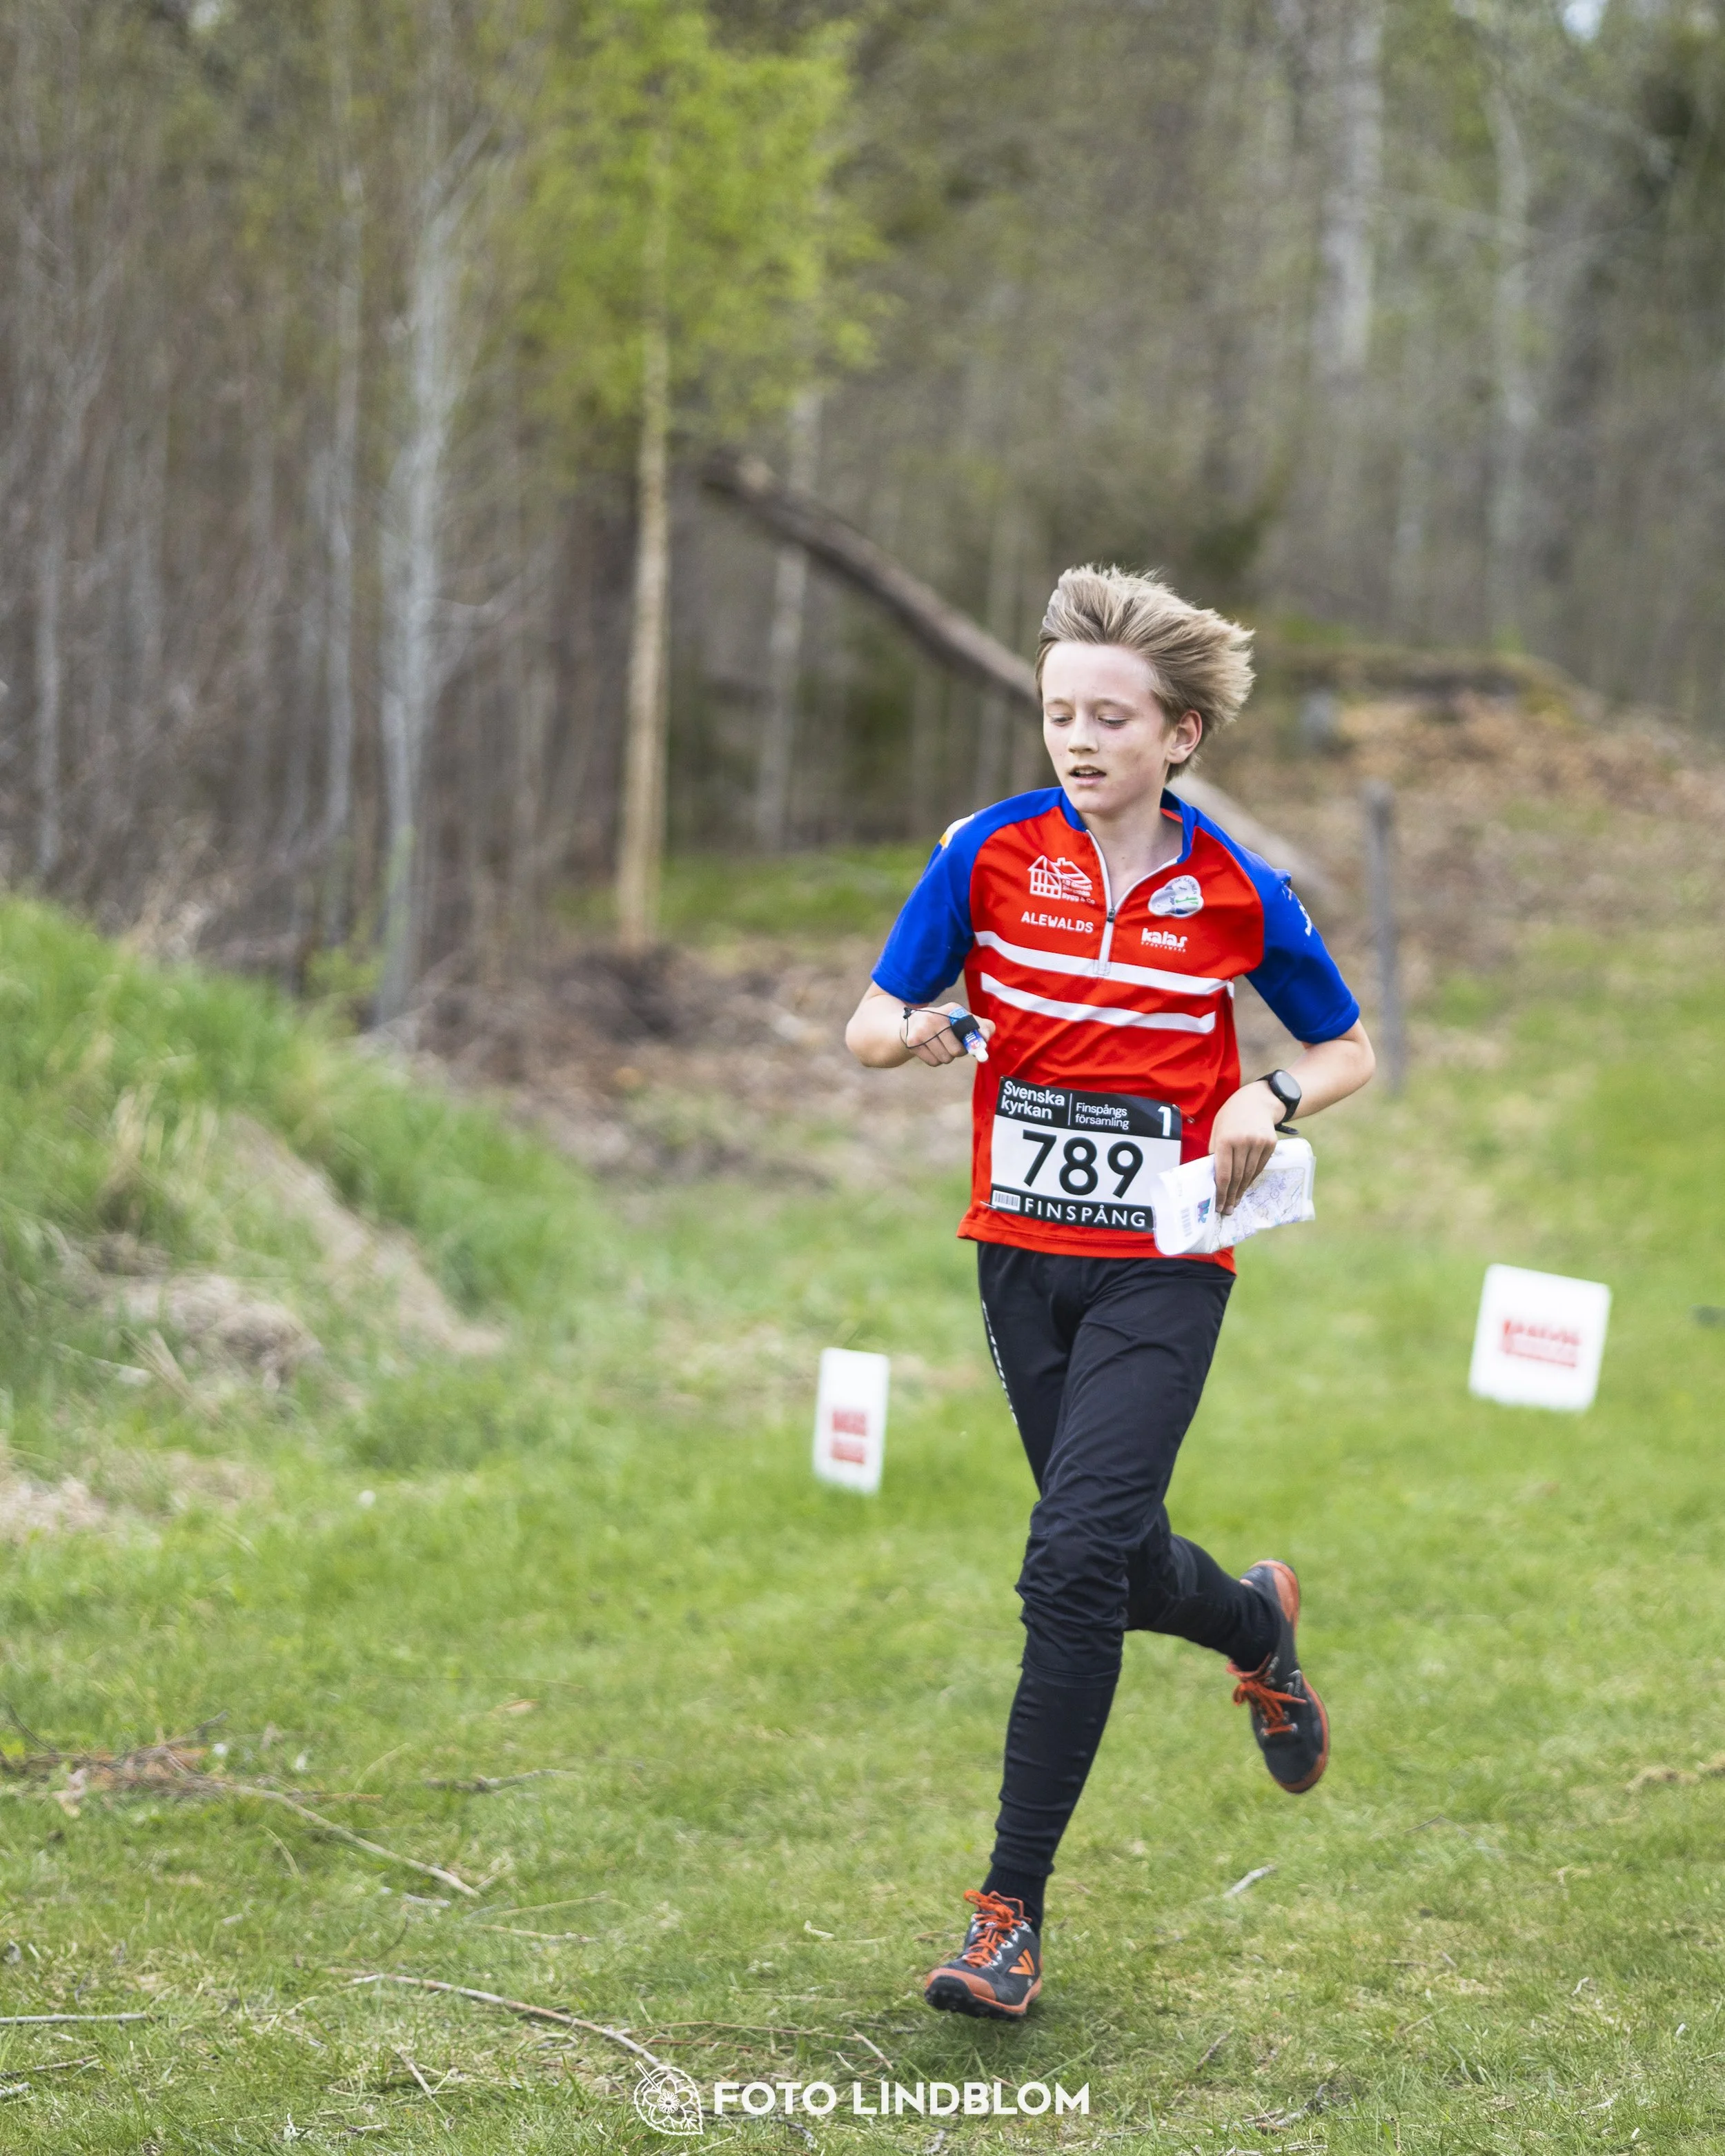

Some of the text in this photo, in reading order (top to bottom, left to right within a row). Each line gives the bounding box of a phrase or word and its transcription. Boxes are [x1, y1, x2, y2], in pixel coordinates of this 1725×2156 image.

[1021, 911, 1094, 933] ALEWALDS
[1141, 927, 1188, 948] kalas
[1003, 1080, 1065, 1106] Svenska
[1001, 1095, 1052, 1120] kyrkan
[1076, 1102, 1127, 1118] Finspångs
[1075, 1113, 1130, 1130] församling
[1157, 1105, 1172, 1136] 1
[1023, 1129, 1143, 1199] 789
[1025, 1198, 1146, 1227] FINSPÅNG
